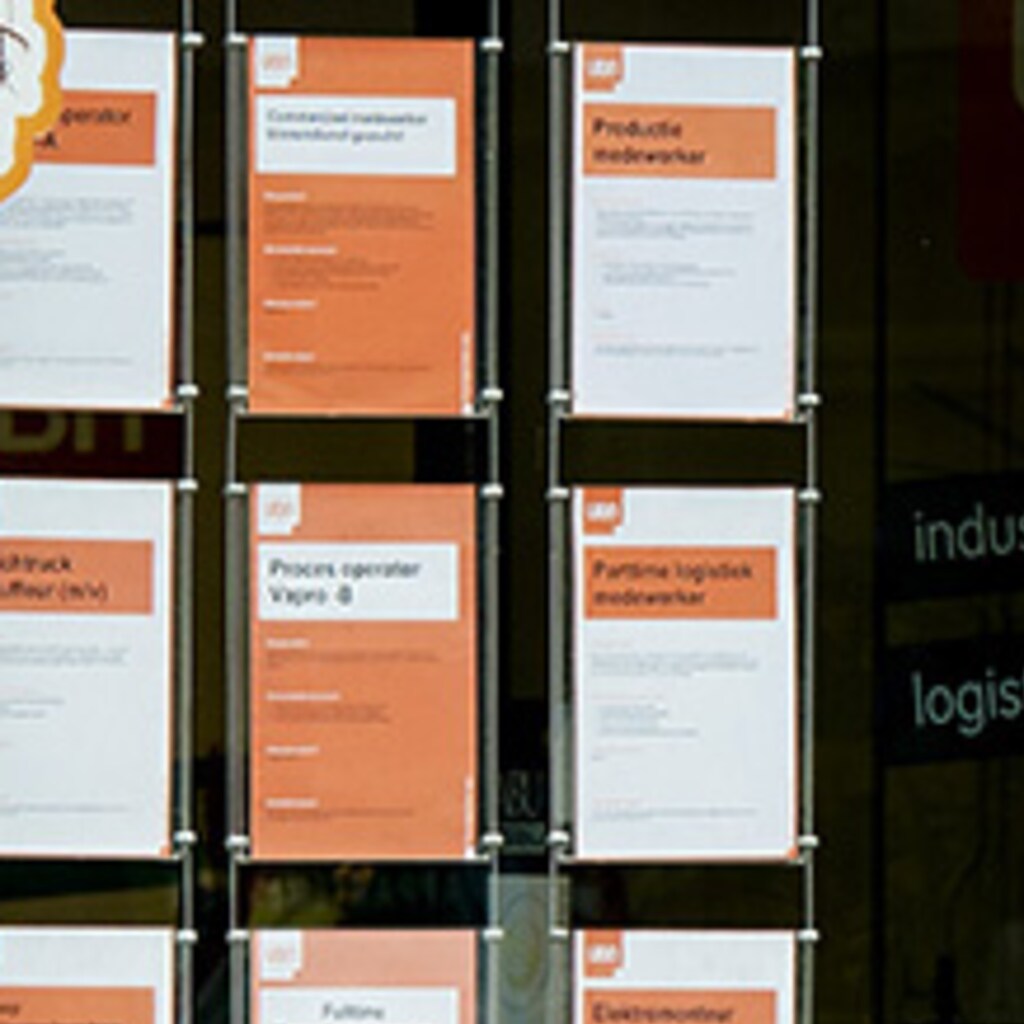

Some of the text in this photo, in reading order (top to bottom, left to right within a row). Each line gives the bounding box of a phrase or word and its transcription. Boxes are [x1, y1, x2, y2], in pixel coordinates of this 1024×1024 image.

[593, 117, 683, 138] Productie
[593, 146, 706, 164] medewerker
[269, 558, 422, 581] Proces operator
[594, 559, 753, 584] Parttime logistiek
[594, 587, 706, 606] medewerker
